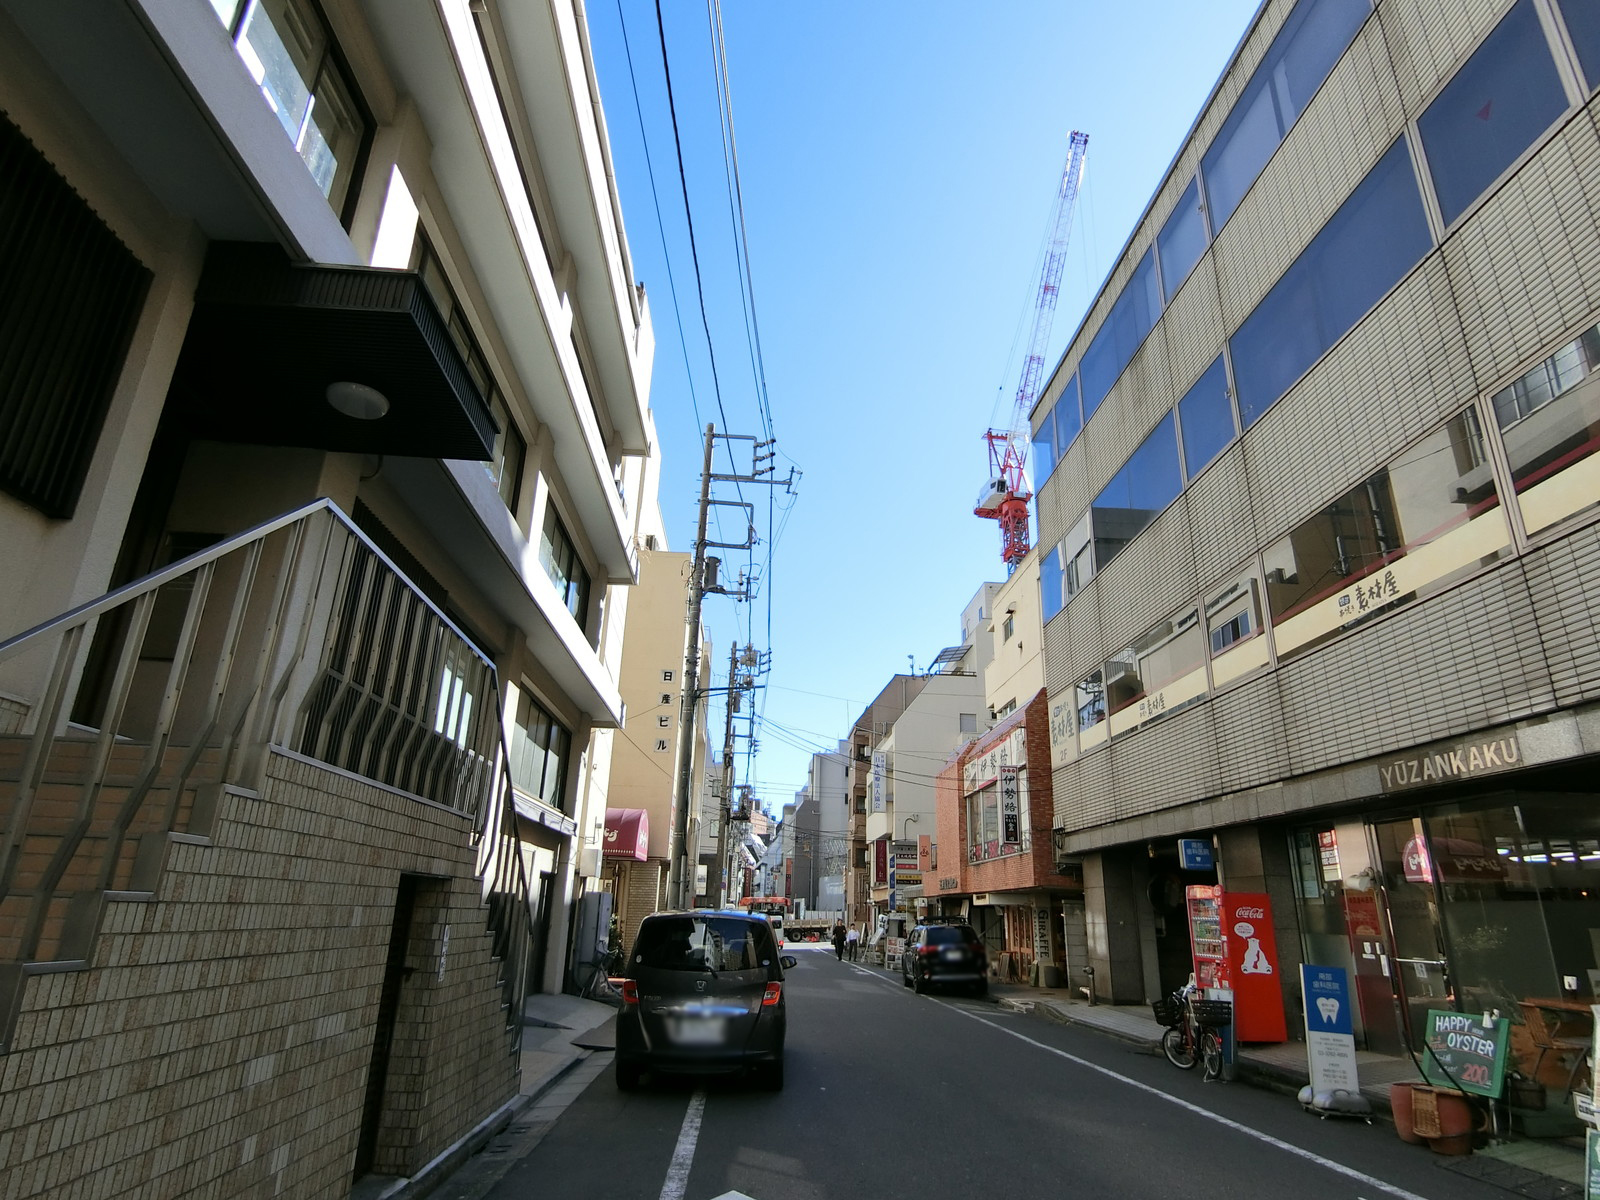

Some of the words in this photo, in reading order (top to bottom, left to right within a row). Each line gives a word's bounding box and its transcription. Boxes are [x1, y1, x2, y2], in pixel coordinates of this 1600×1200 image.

[1355, 570, 1400, 613] 素材屋
[657, 671, 673, 751] 日産ビル
[1051, 709, 1075, 748] 素材屋
[1060, 748, 1068, 762] 2F
[1003, 775, 1017, 813] 伊勢路
[1038, 909, 1050, 959] GIRAFFE
[1435, 1015, 1472, 1033] HAPPY
[1447, 1032, 1494, 1057] OYSTER
[1461, 1062, 1489, 1085] 200
